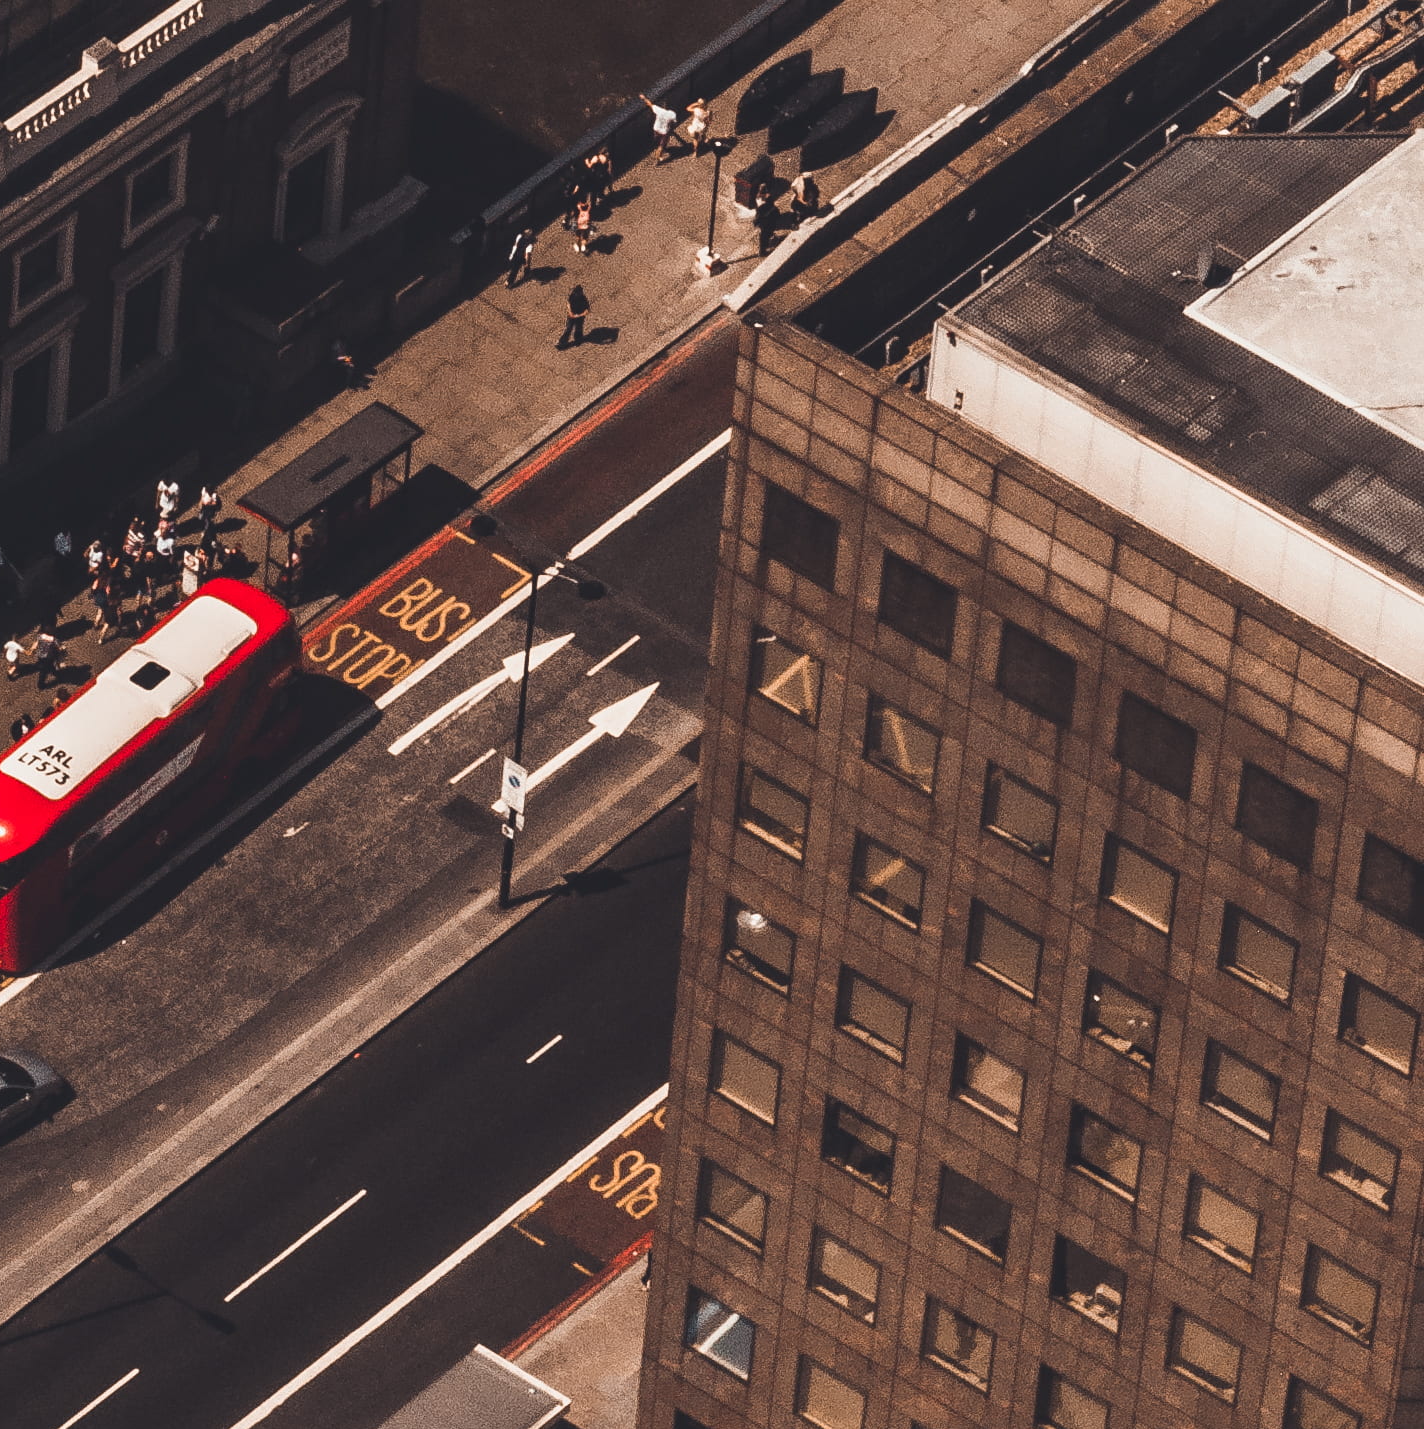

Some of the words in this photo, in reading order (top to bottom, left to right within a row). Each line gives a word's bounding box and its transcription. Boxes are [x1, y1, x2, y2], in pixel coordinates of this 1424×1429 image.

[379, 577, 472, 642] BUS
[307, 623, 412, 690] STOP
[18, 753, 70, 785] LT573
[39, 745, 73, 768] ARL
